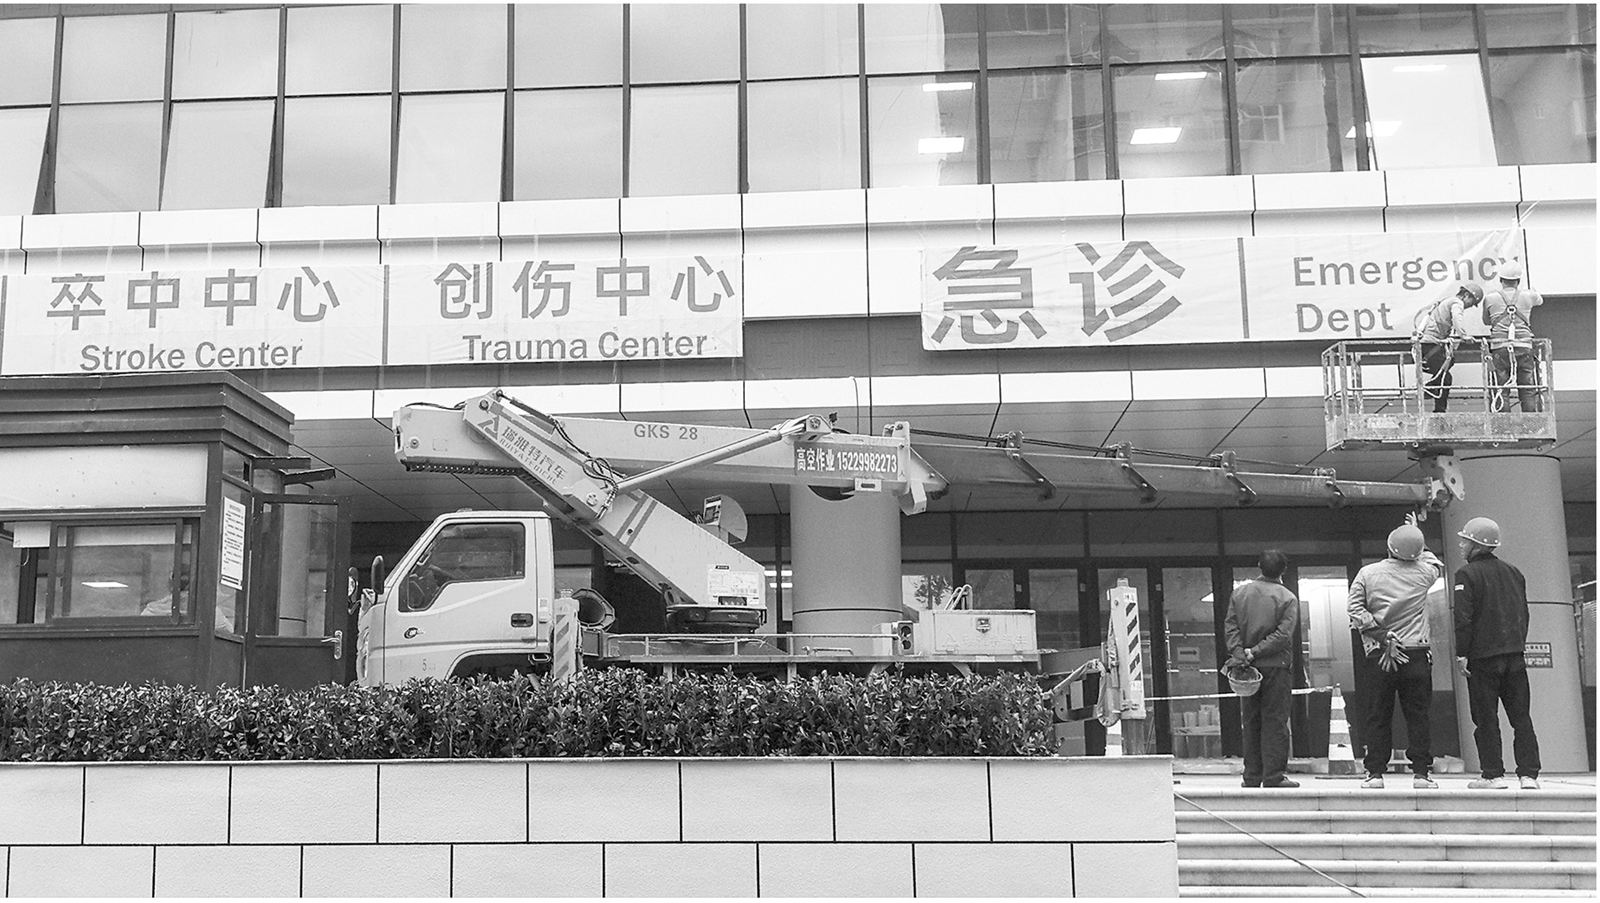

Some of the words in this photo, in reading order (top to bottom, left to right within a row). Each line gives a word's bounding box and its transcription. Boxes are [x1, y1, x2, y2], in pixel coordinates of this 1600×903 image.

[46, 266, 341, 331] 卒中中心
[433, 256, 736, 320] 创伤中心
[931, 241, 1186, 344] 急诊
[1296, 303, 1394, 337] Dept
[80, 344, 186, 371] Stroke
[195, 340, 303, 368] Center
[462, 335, 588, 361] Trauma
[598, 331, 708, 358] Center
[633, 423, 670, 439] GKS
[679, 426, 699, 441] 28
[797, 447, 835, 471] 高空作业
[837, 451, 897, 473] 15229982273
